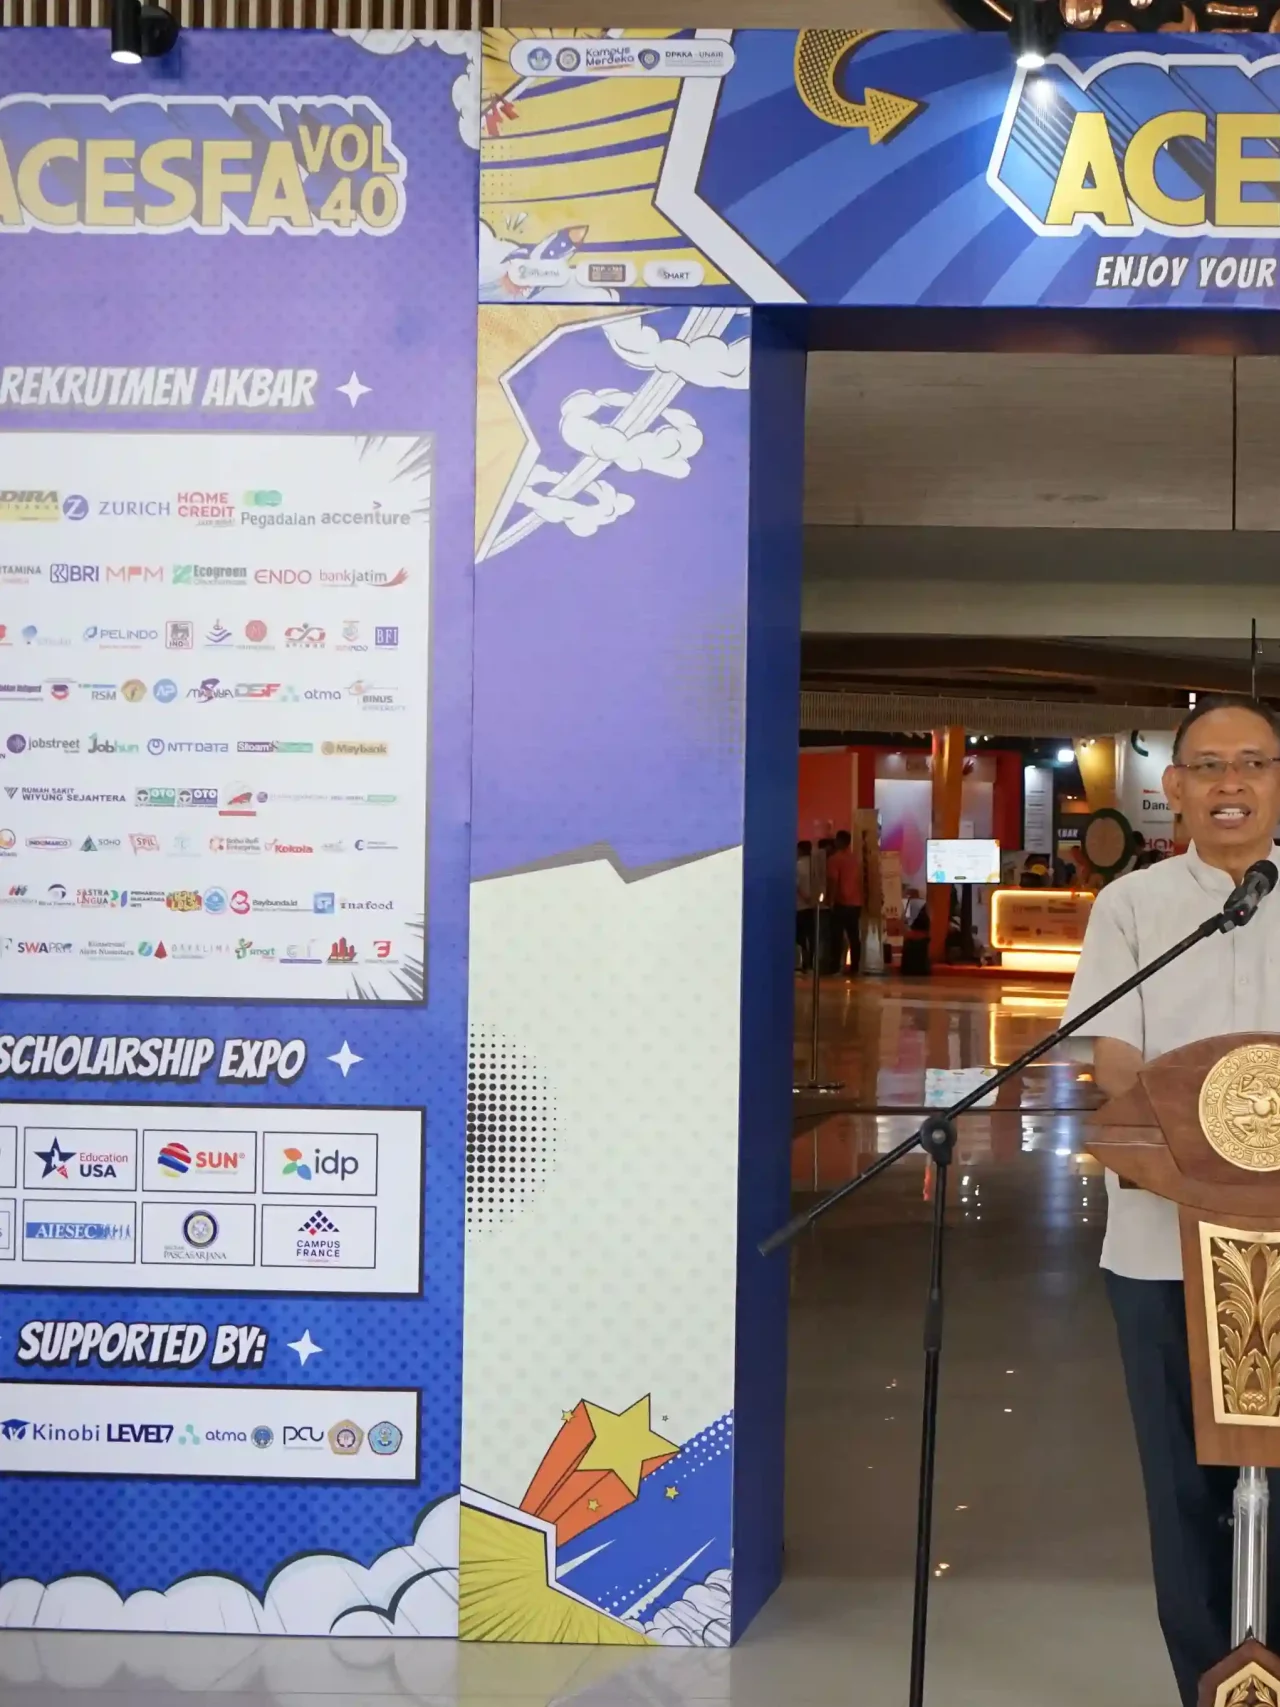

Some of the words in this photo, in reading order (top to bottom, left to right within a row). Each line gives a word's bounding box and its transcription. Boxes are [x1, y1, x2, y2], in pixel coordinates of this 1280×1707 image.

[586, 47, 631, 58] Kampus
[586, 55, 635, 67] Merdeka
[298, 122, 399, 174] VOL
[319, 175, 399, 228] 40
[1096, 254, 1191, 289] ENJOY
[1199, 255, 1278, 289] YOUR
[1, 365, 198, 408] REKRUTMEN
[201, 368, 318, 409] AKBAR
[177, 492, 229, 503] HOME
[98, 501, 171, 516] ZURICH
[177, 505, 236, 518] CREDIT
[240, 511, 316, 529] Pegadaian
[320, 510, 411, 526] accenture
[69, 565, 100, 582] BRI
[105, 566, 164, 582] MPM
[253, 569, 312, 584] ENDO
[99, 629, 159, 640] PELINDO
[90, 690, 117, 701] RSM
[303, 689, 342, 700] atma
[27, 738, 81, 755] jobstreet
[336, 743, 388, 756] Maybank
[21, 793, 64, 802] WIYUNG
[151, 789, 176, 799] OTO
[193, 789, 218, 800] OTO
[0, 1035, 214, 1077] SCHOLARSHIP
[218, 1038, 307, 1080] EXPO
[79, 1152, 129, 1163] Education
[314, 1148, 359, 1181] idp
[79, 1164, 117, 1178] USA
[36, 1224, 98, 1238] AIESEC
[296, 1239, 340, 1249] CAMPUS
[296, 1248, 340, 1257] FRANCE
[17, 1320, 207, 1364] SUPPORTED
[211, 1324, 267, 1365] BY:
[32, 1423, 100, 1442] Kinobi
[205, 1429, 247, 1442] atma
